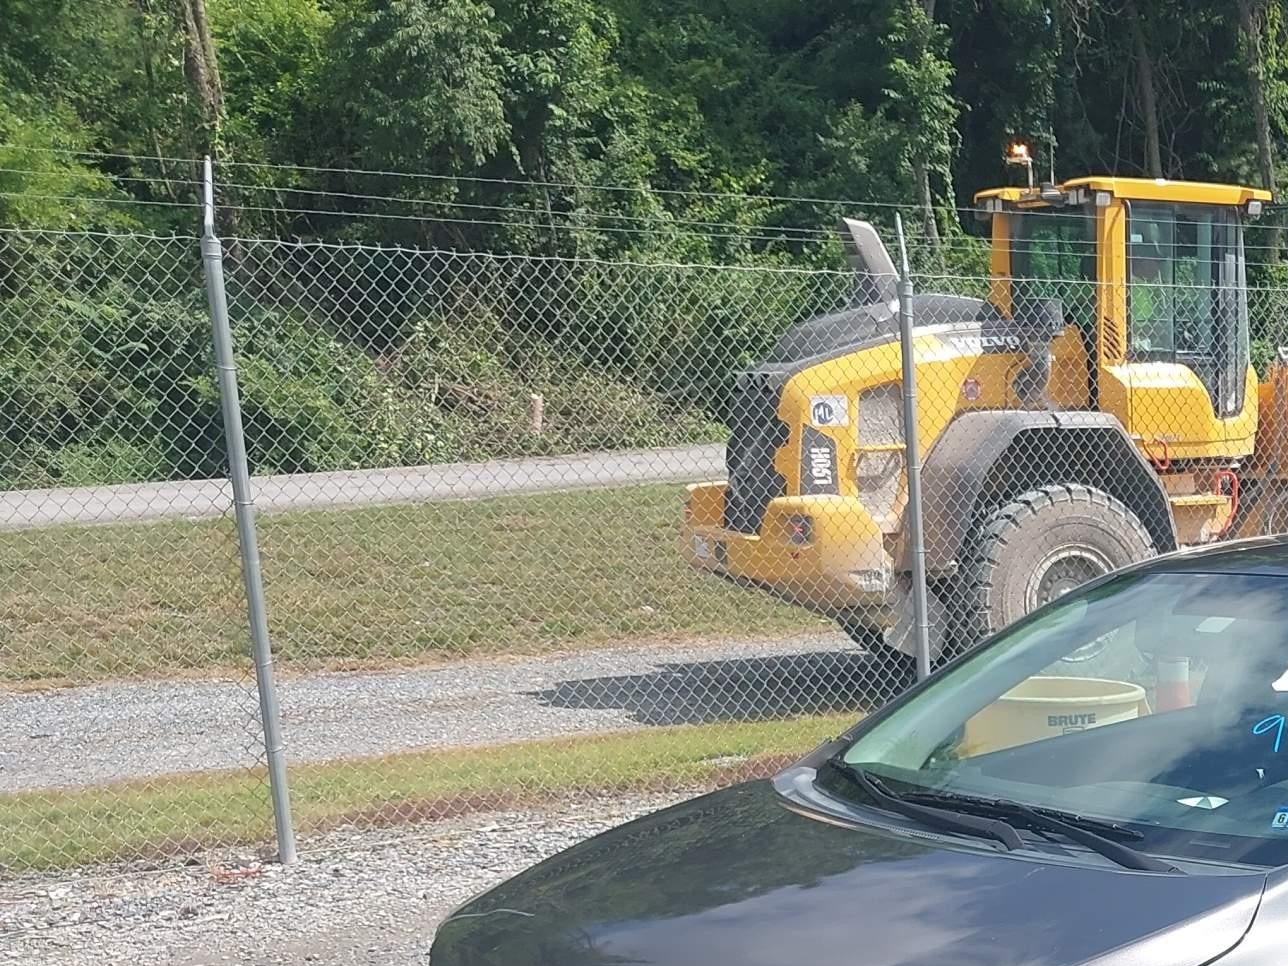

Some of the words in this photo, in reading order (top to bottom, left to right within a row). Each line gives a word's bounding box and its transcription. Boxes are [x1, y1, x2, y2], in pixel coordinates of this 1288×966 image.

[950, 335, 1020, 349] VOLVO
[1047, 713, 1097, 727] BRUTE
[1277, 813, 1287, 824] 6
